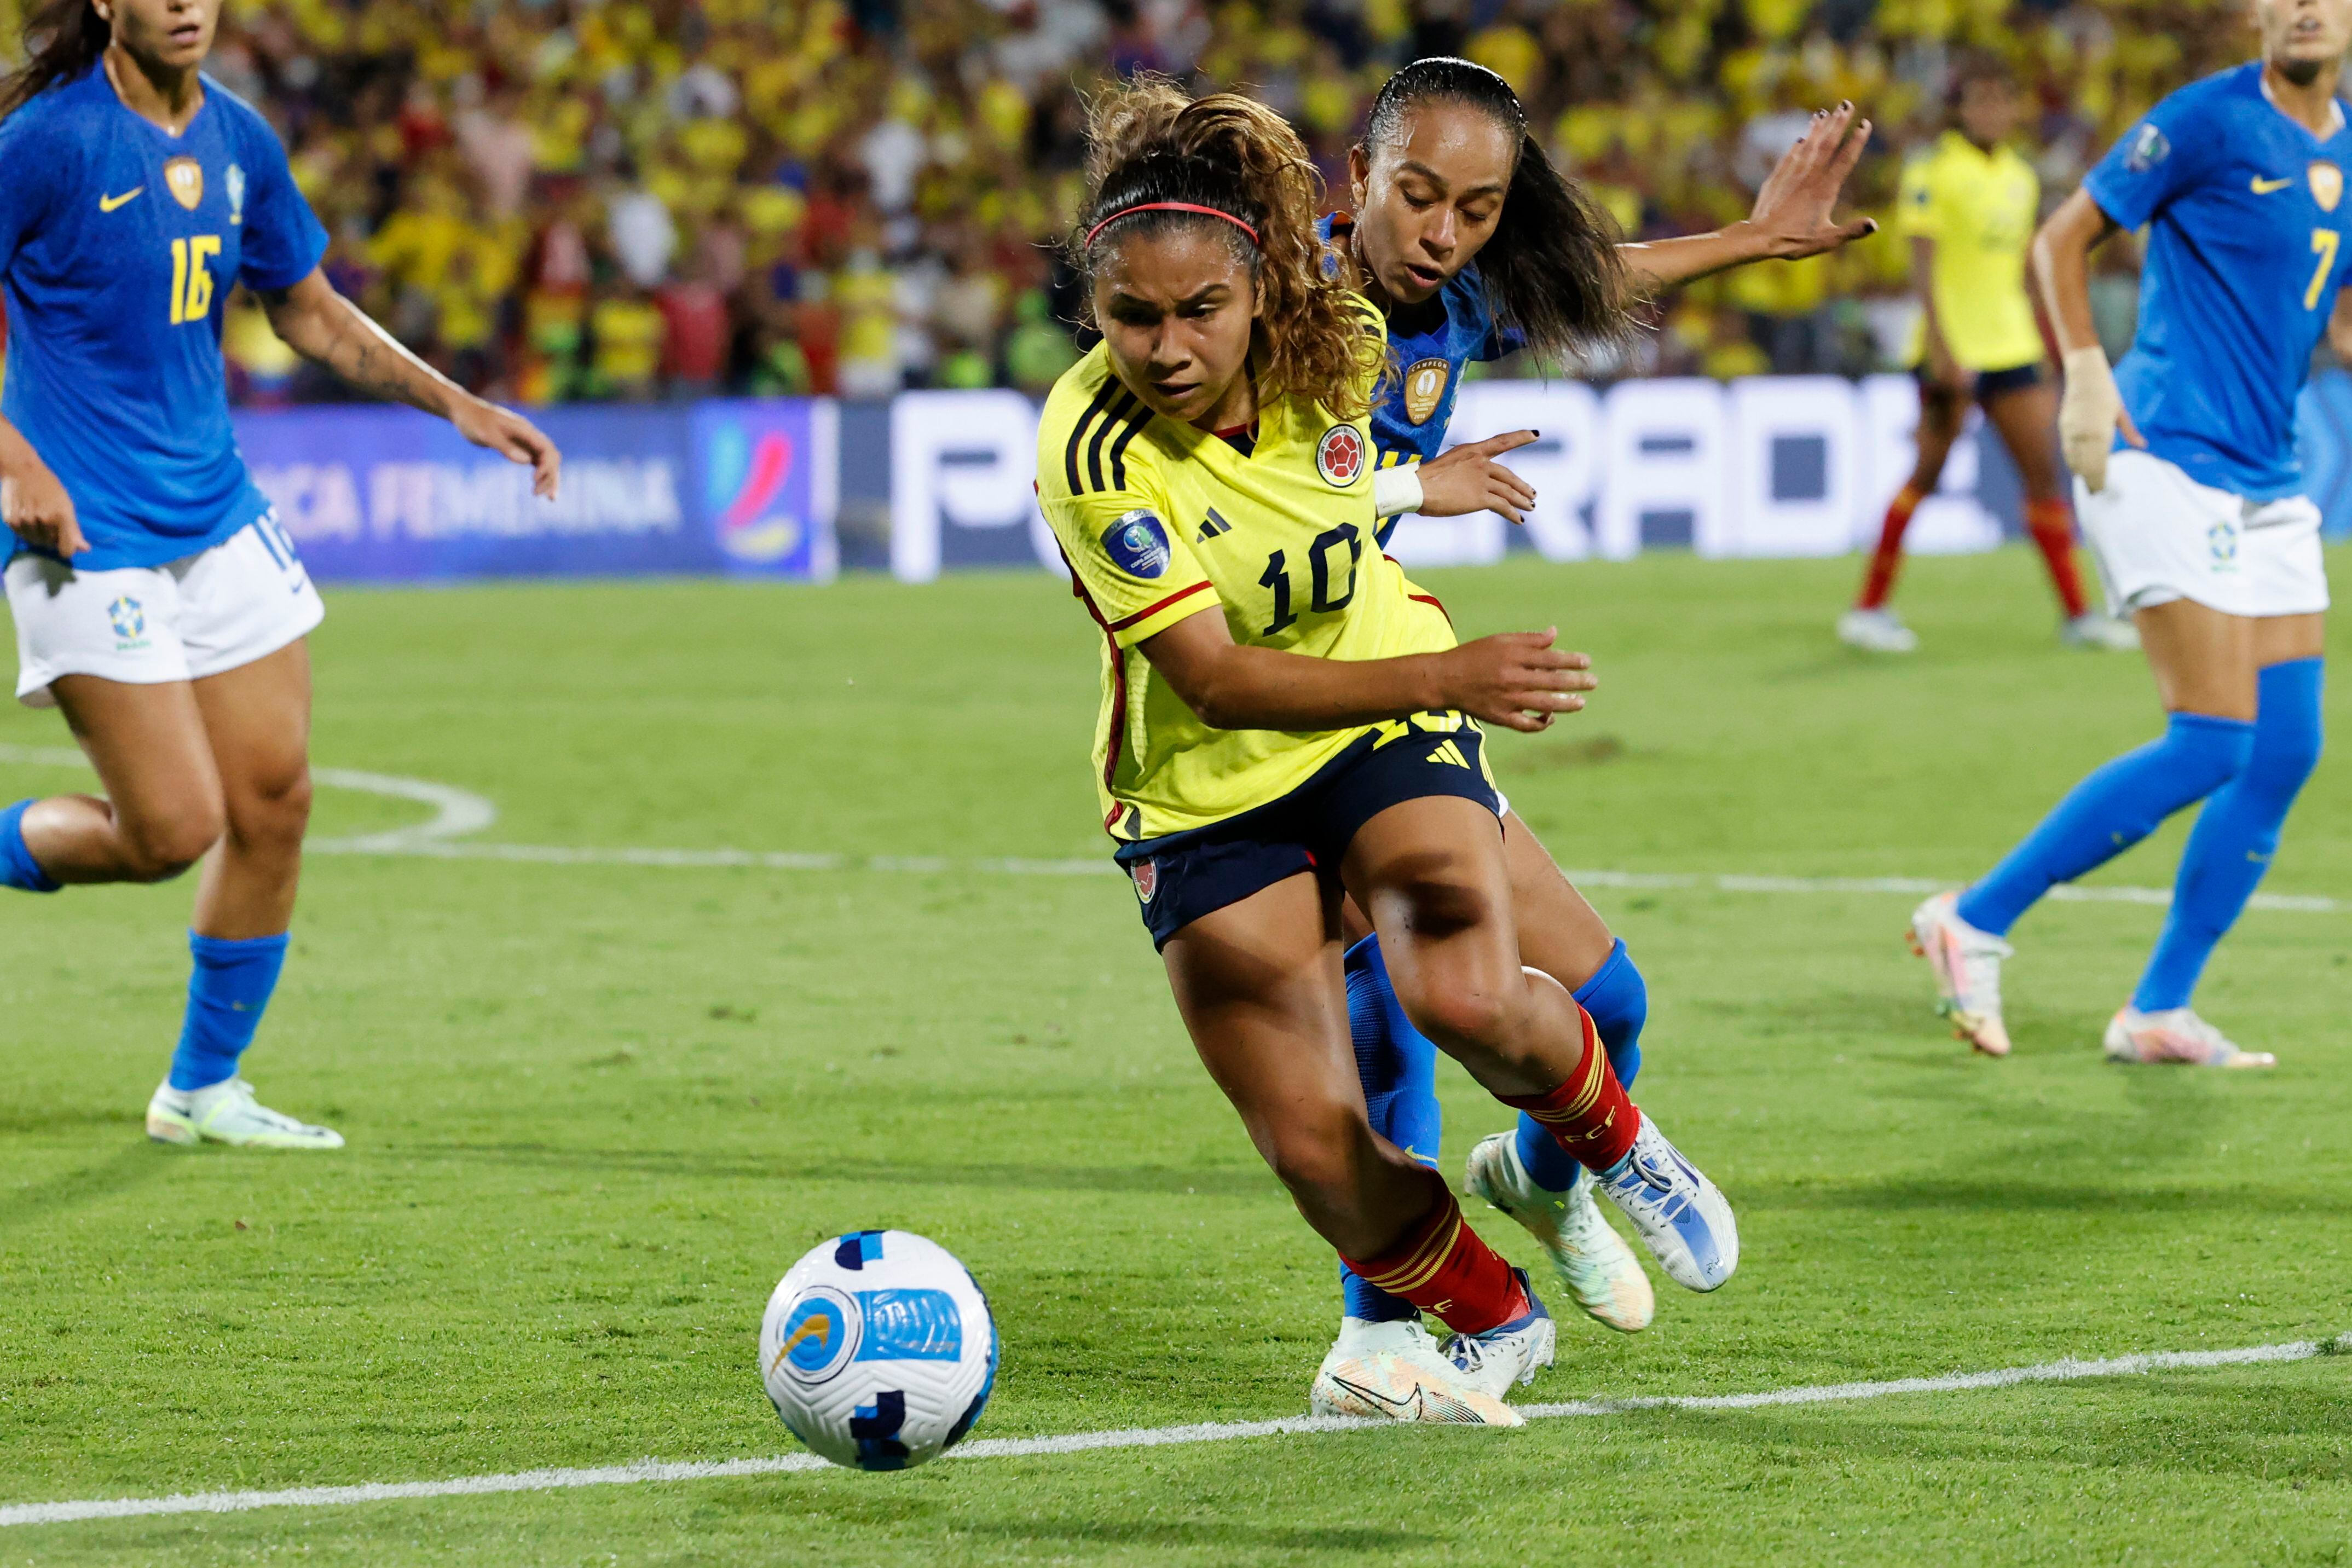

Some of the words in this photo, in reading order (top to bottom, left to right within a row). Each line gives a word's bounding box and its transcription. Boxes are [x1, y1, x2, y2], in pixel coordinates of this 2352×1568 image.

[170, 234, 222, 325] 16
[2303, 227, 2341, 311] 7
[1411, 361, 1448, 372] CAMPEÓN
[1258, 522, 1362, 637] 10
[1564, 1106, 1616, 1143] FCF
